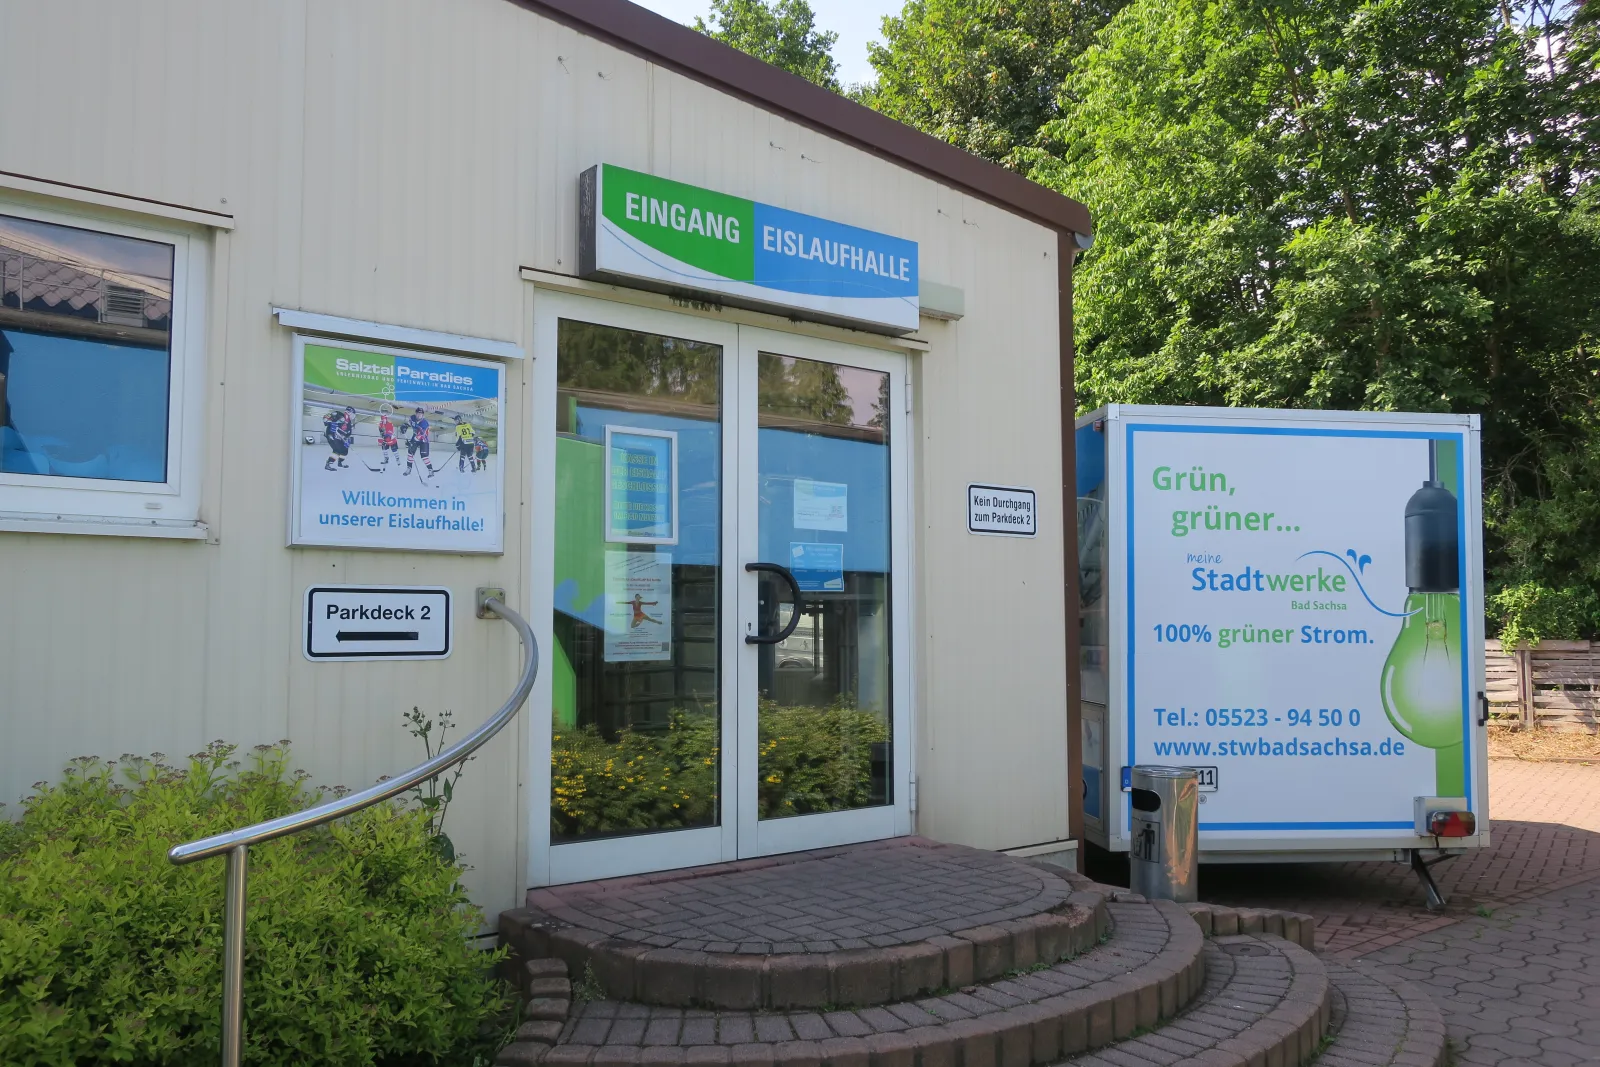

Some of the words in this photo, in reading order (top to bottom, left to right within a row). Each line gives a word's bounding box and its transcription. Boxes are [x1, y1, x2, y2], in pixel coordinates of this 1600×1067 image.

[625, 192, 740, 244] EINGANG
[763, 225, 910, 282] EISLAUFHALLE
[335, 358, 394, 376] Salztal
[397, 366, 473, 386] Paradies
[1152, 466, 1236, 496] Grün,
[341, 490, 447, 510] Willkommen
[452, 497, 466, 511] in
[974, 495, 991, 507] Kein
[993, 496, 1031, 512] Durchgang
[319, 513, 384, 527] unserer
[388, 513, 484, 532] Eislaufhalle!
[974, 513, 990, 522] zum
[992, 512, 1024, 525] Parkdeck
[1026, 514, 1031, 525] 2
[1171, 505, 1300, 537] grüner...
[1187, 551, 1223, 564] meine
[1191, 566, 1347, 592] Stadtwerke
[326, 604, 415, 620] Parkdeck
[420, 605, 431, 620] 2
[1291, 600, 1311, 610] Bad
[1312, 600, 1347, 611] Sachsa
[1153, 623, 1212, 643] 100%
[1218, 624, 1295, 648] grüner
[1300, 625, 1374, 644] Strom.
[1153, 708, 1199, 727] Tel.:
[1205, 708, 1268, 727] 05523
[1287, 708, 1312, 727] 94
[1318, 709, 1343, 727] 50
[1348, 709, 1361, 727] 0
[1153, 737, 1405, 756] www.stwbadsachsa.de
